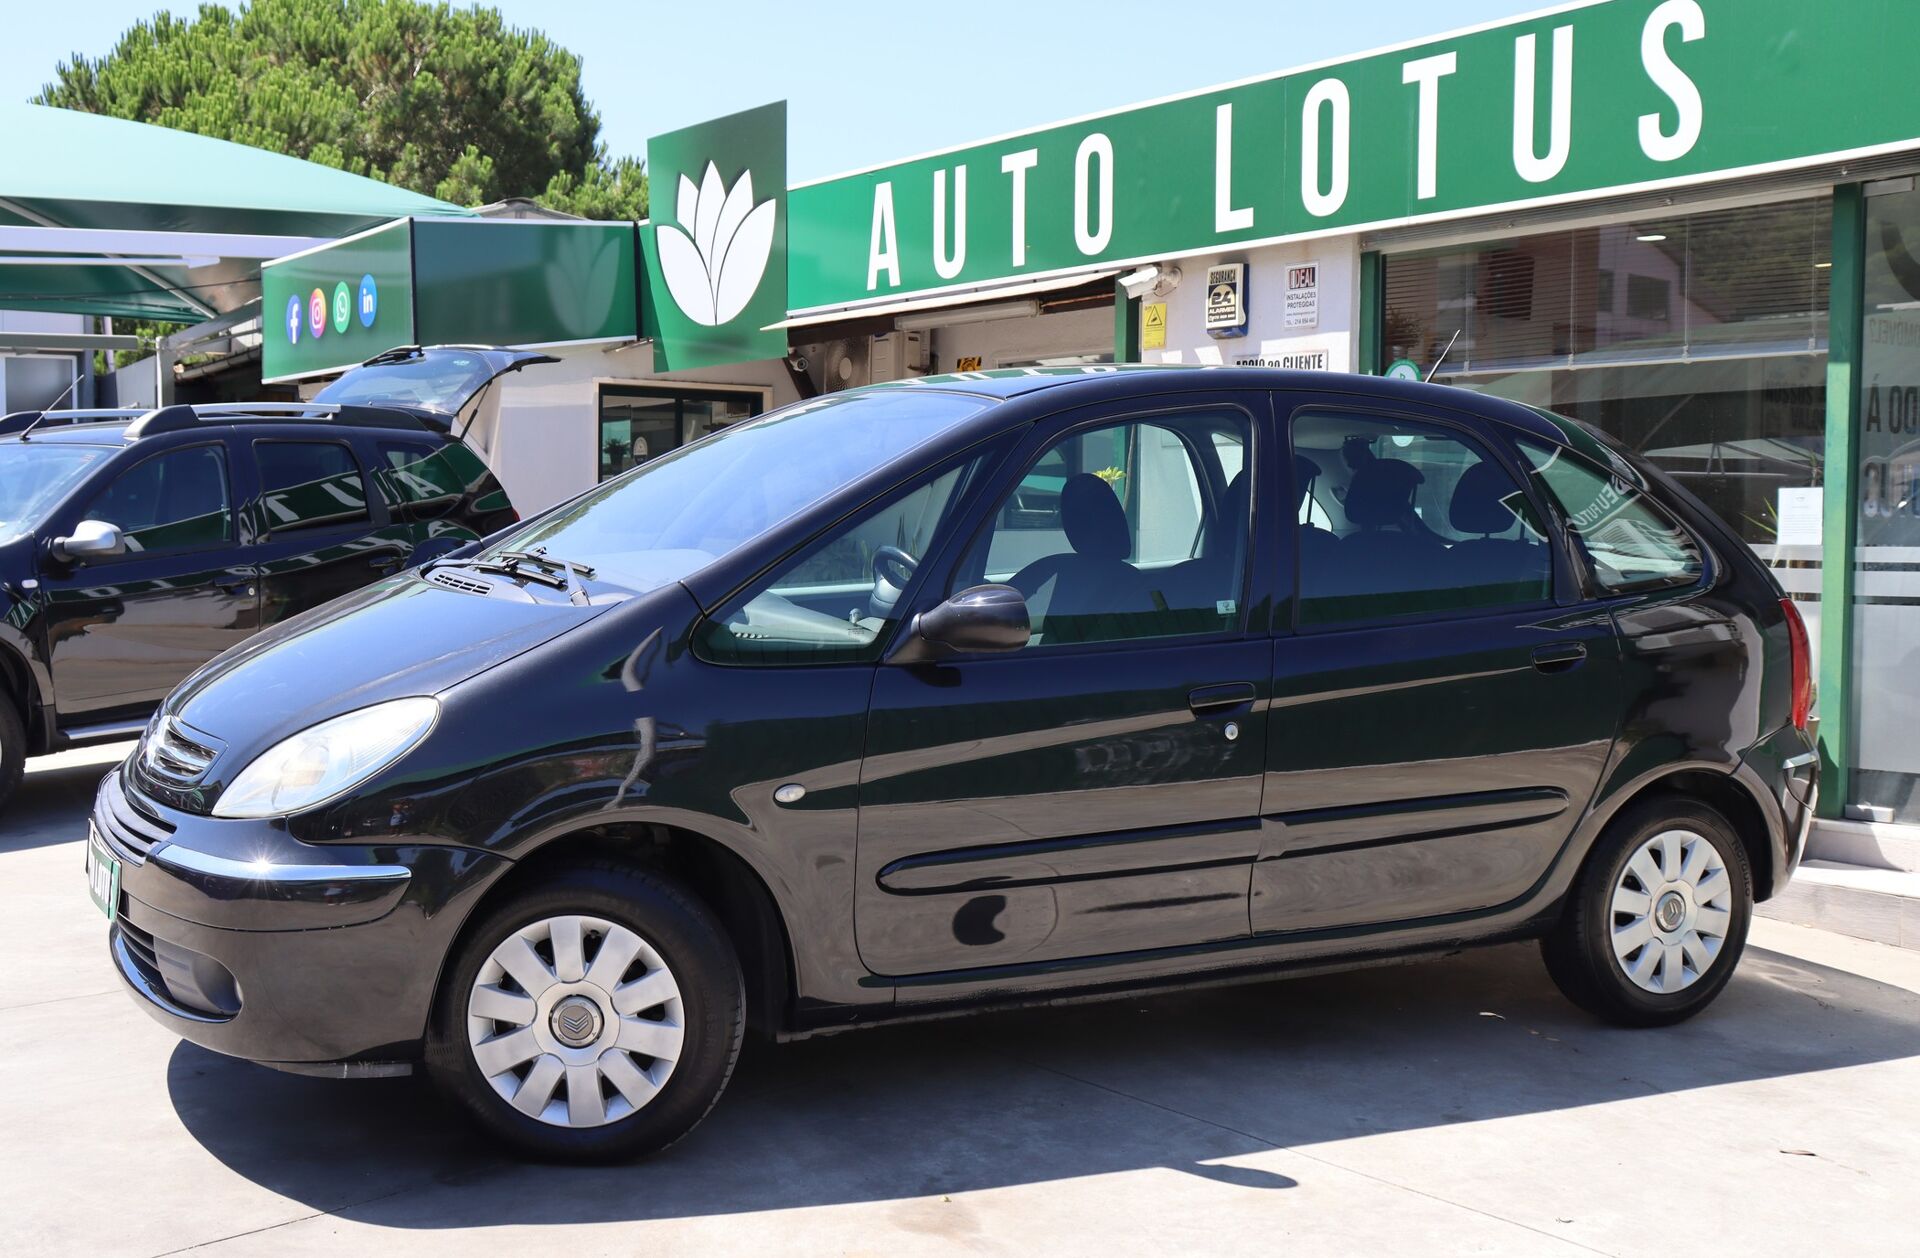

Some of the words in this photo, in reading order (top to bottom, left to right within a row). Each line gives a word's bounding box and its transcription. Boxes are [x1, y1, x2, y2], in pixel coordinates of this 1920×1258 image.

[867, 133, 1113, 290] AUTO
[1215, 0, 1706, 233] LOTUS
[1290, 267, 1315, 289] IDEAL
[1208, 305, 1235, 314] ALARMES
[1283, 353, 1323, 370] CLIENTE
